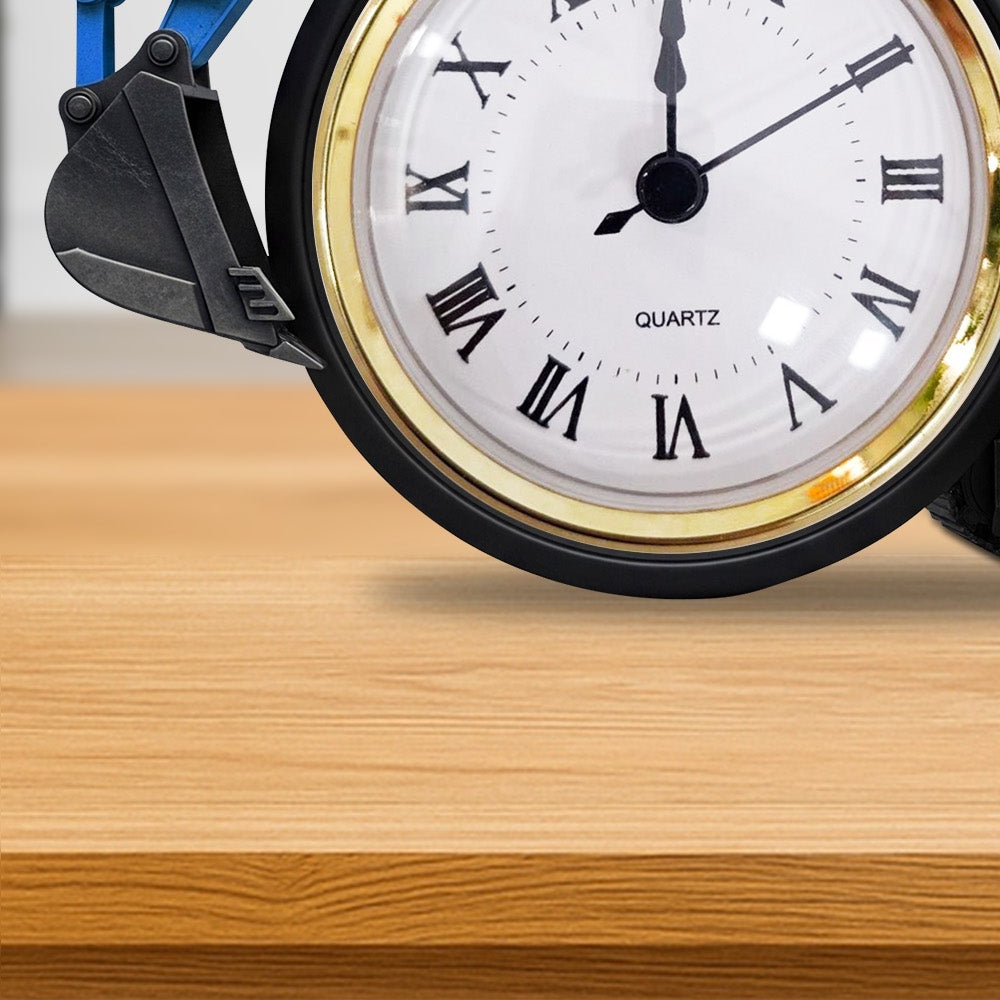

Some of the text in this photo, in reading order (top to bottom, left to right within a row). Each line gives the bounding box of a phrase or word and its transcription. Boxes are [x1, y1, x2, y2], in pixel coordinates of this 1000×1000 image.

[433, 32, 511, 108] X
[845, 34, 913, 92] II
[405, 161, 470, 215] IX
[881, 154, 943, 204] III
[426, 262, 506, 363] VIII
[635, 309, 720, 329] QUARTZ
[851, 265, 920, 342] IV
[516, 354, 589, 441] VII
[651, 394, 711, 460] VI
[781, 362, 838, 431] V
